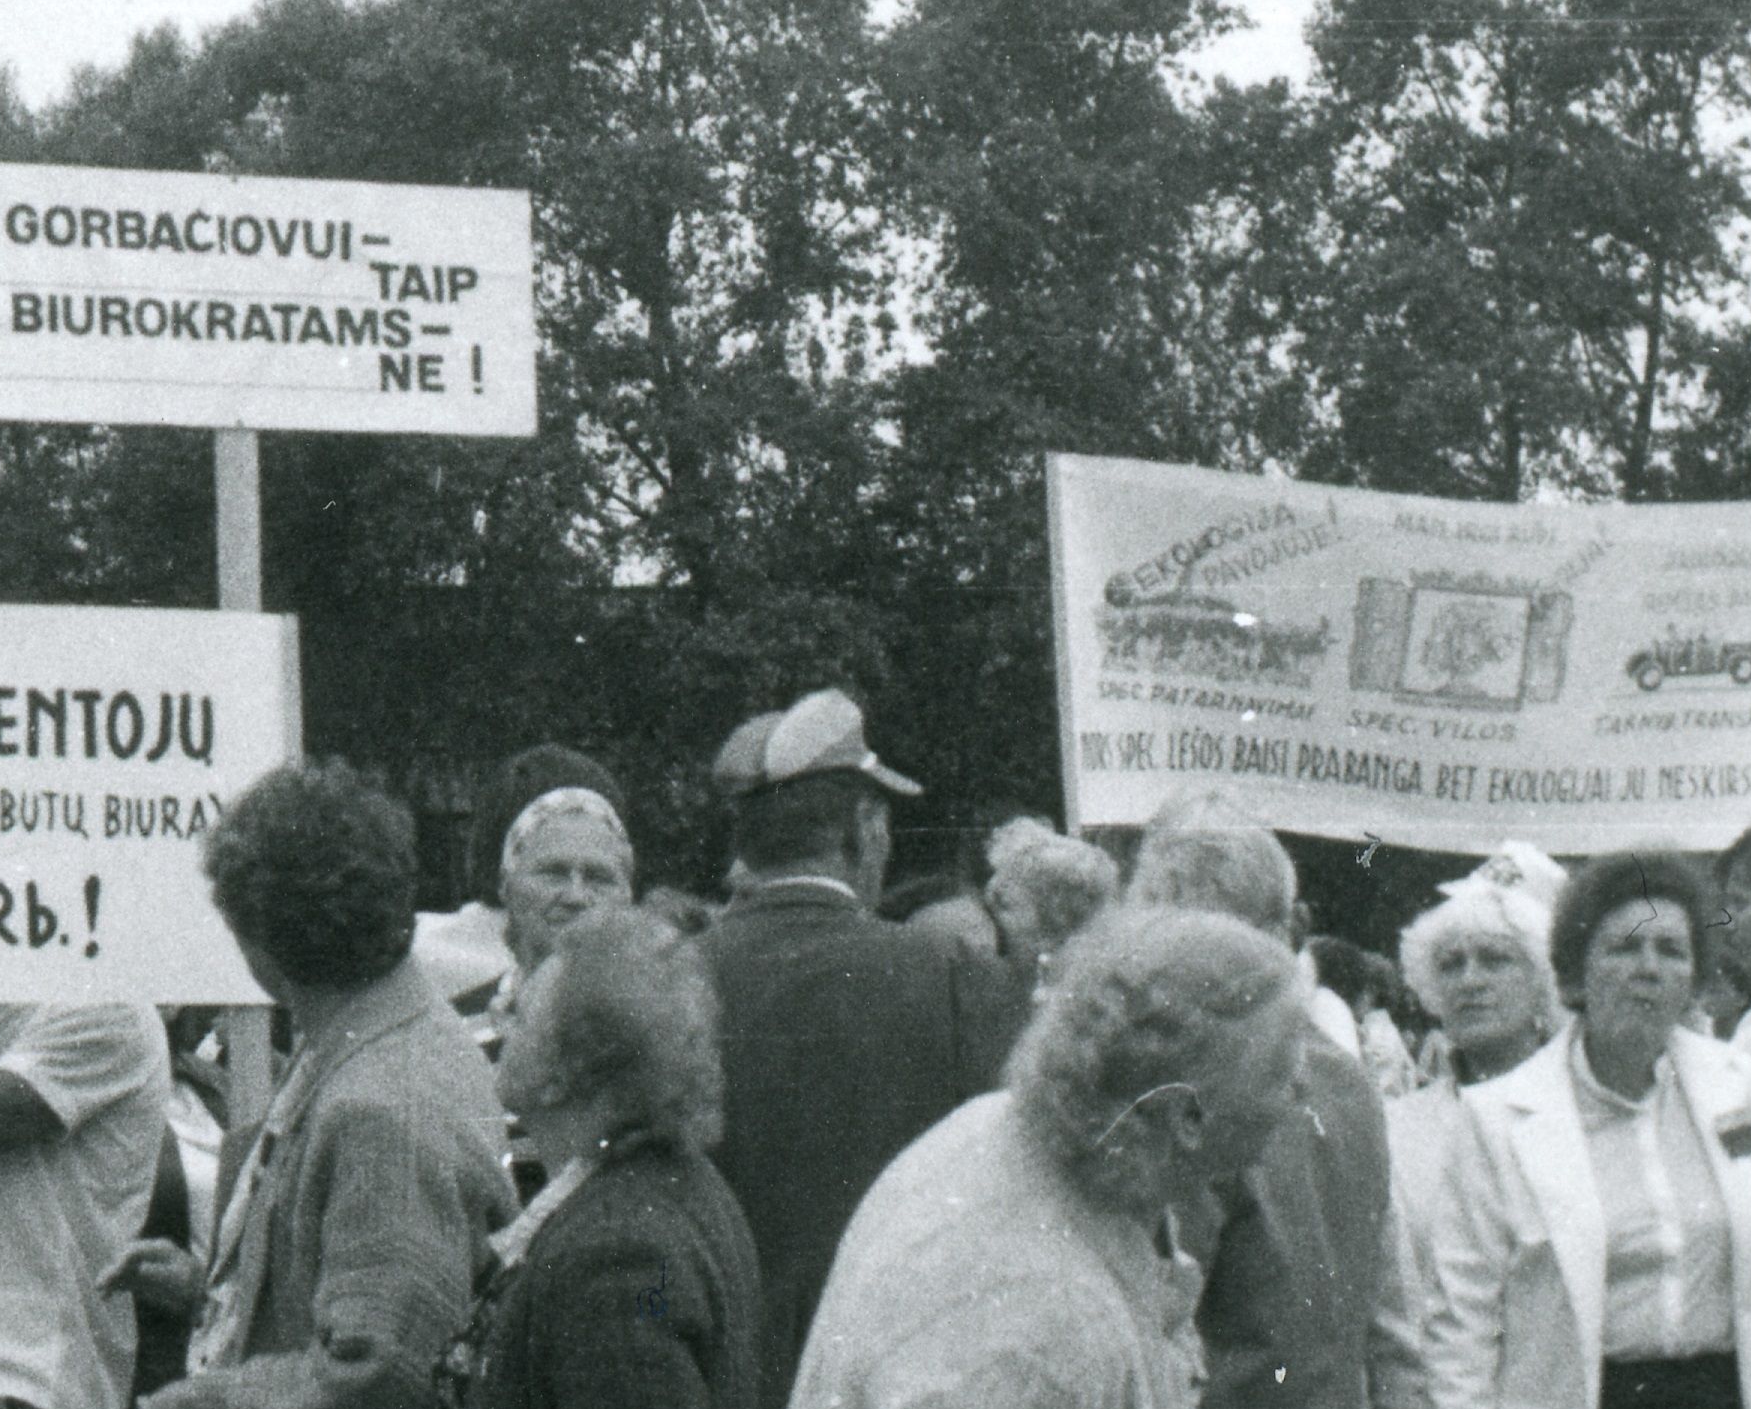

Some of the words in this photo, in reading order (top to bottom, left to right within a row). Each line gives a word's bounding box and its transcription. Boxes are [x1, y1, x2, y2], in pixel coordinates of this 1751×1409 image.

[369, 260, 480, 305] TAIP
[1133, 502, 1297, 591] EKOLOGIJA
[1296, 742, 1422, 792] PRABANGA
[1436, 762, 1477, 803] BET
